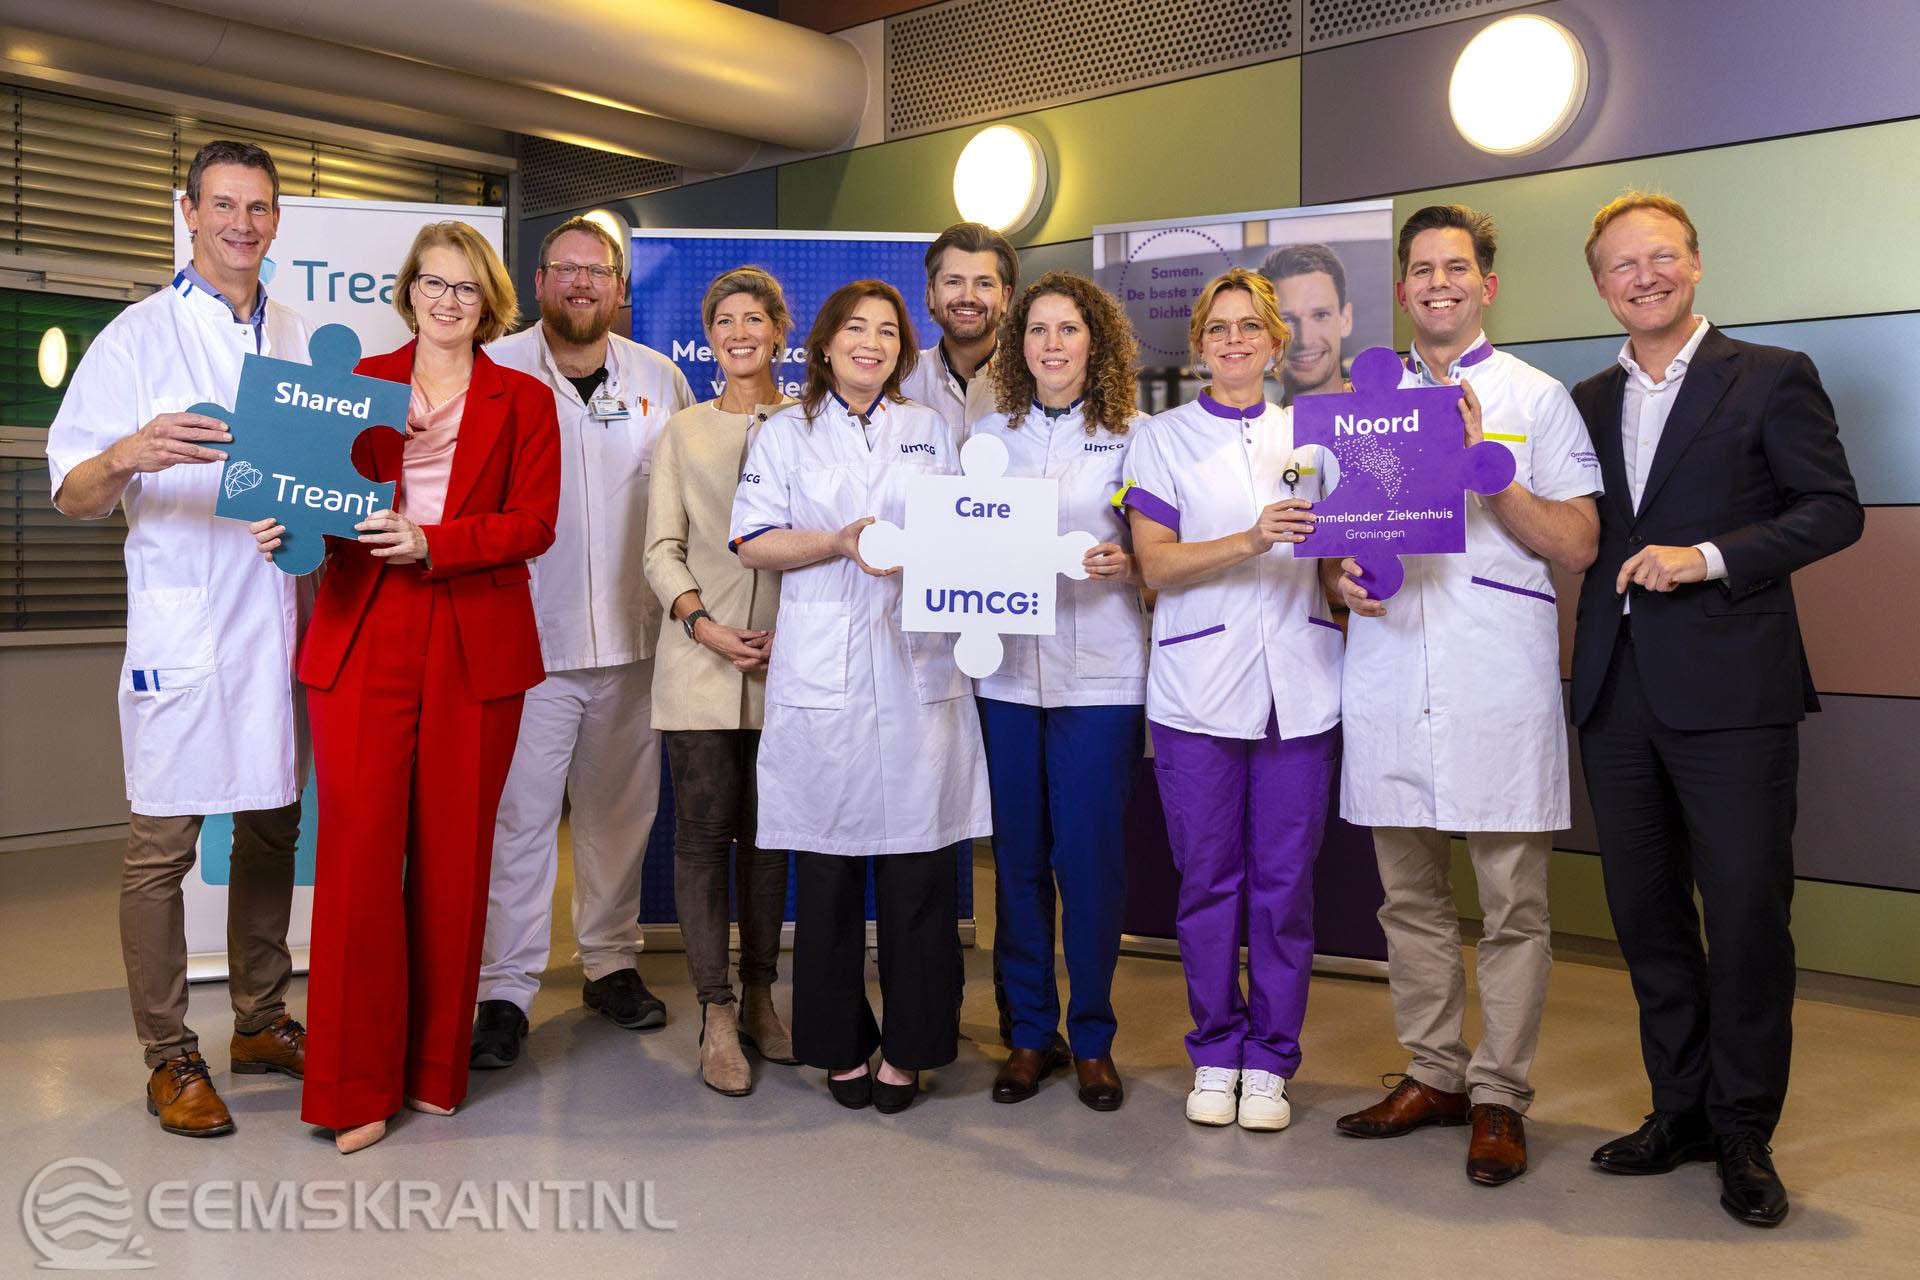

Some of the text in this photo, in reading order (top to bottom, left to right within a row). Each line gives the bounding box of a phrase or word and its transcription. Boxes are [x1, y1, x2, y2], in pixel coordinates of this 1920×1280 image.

[292, 260, 397, 305] Trea
[1151, 267, 1204, 279] Samen.
[1127, 289, 1145, 300] De
[1150, 288, 1187, 299] beste
[1150, 304, 1192, 319] Dichtb
[274, 381, 371, 419] Shared
[1334, 409, 1419, 436] Noord
[272, 473, 379, 516] Treant
[955, 496, 1011, 519] Care
[1314, 508, 1453, 524] mmelander Ziekenhuis
[1345, 529, 1405, 540] Groningen
